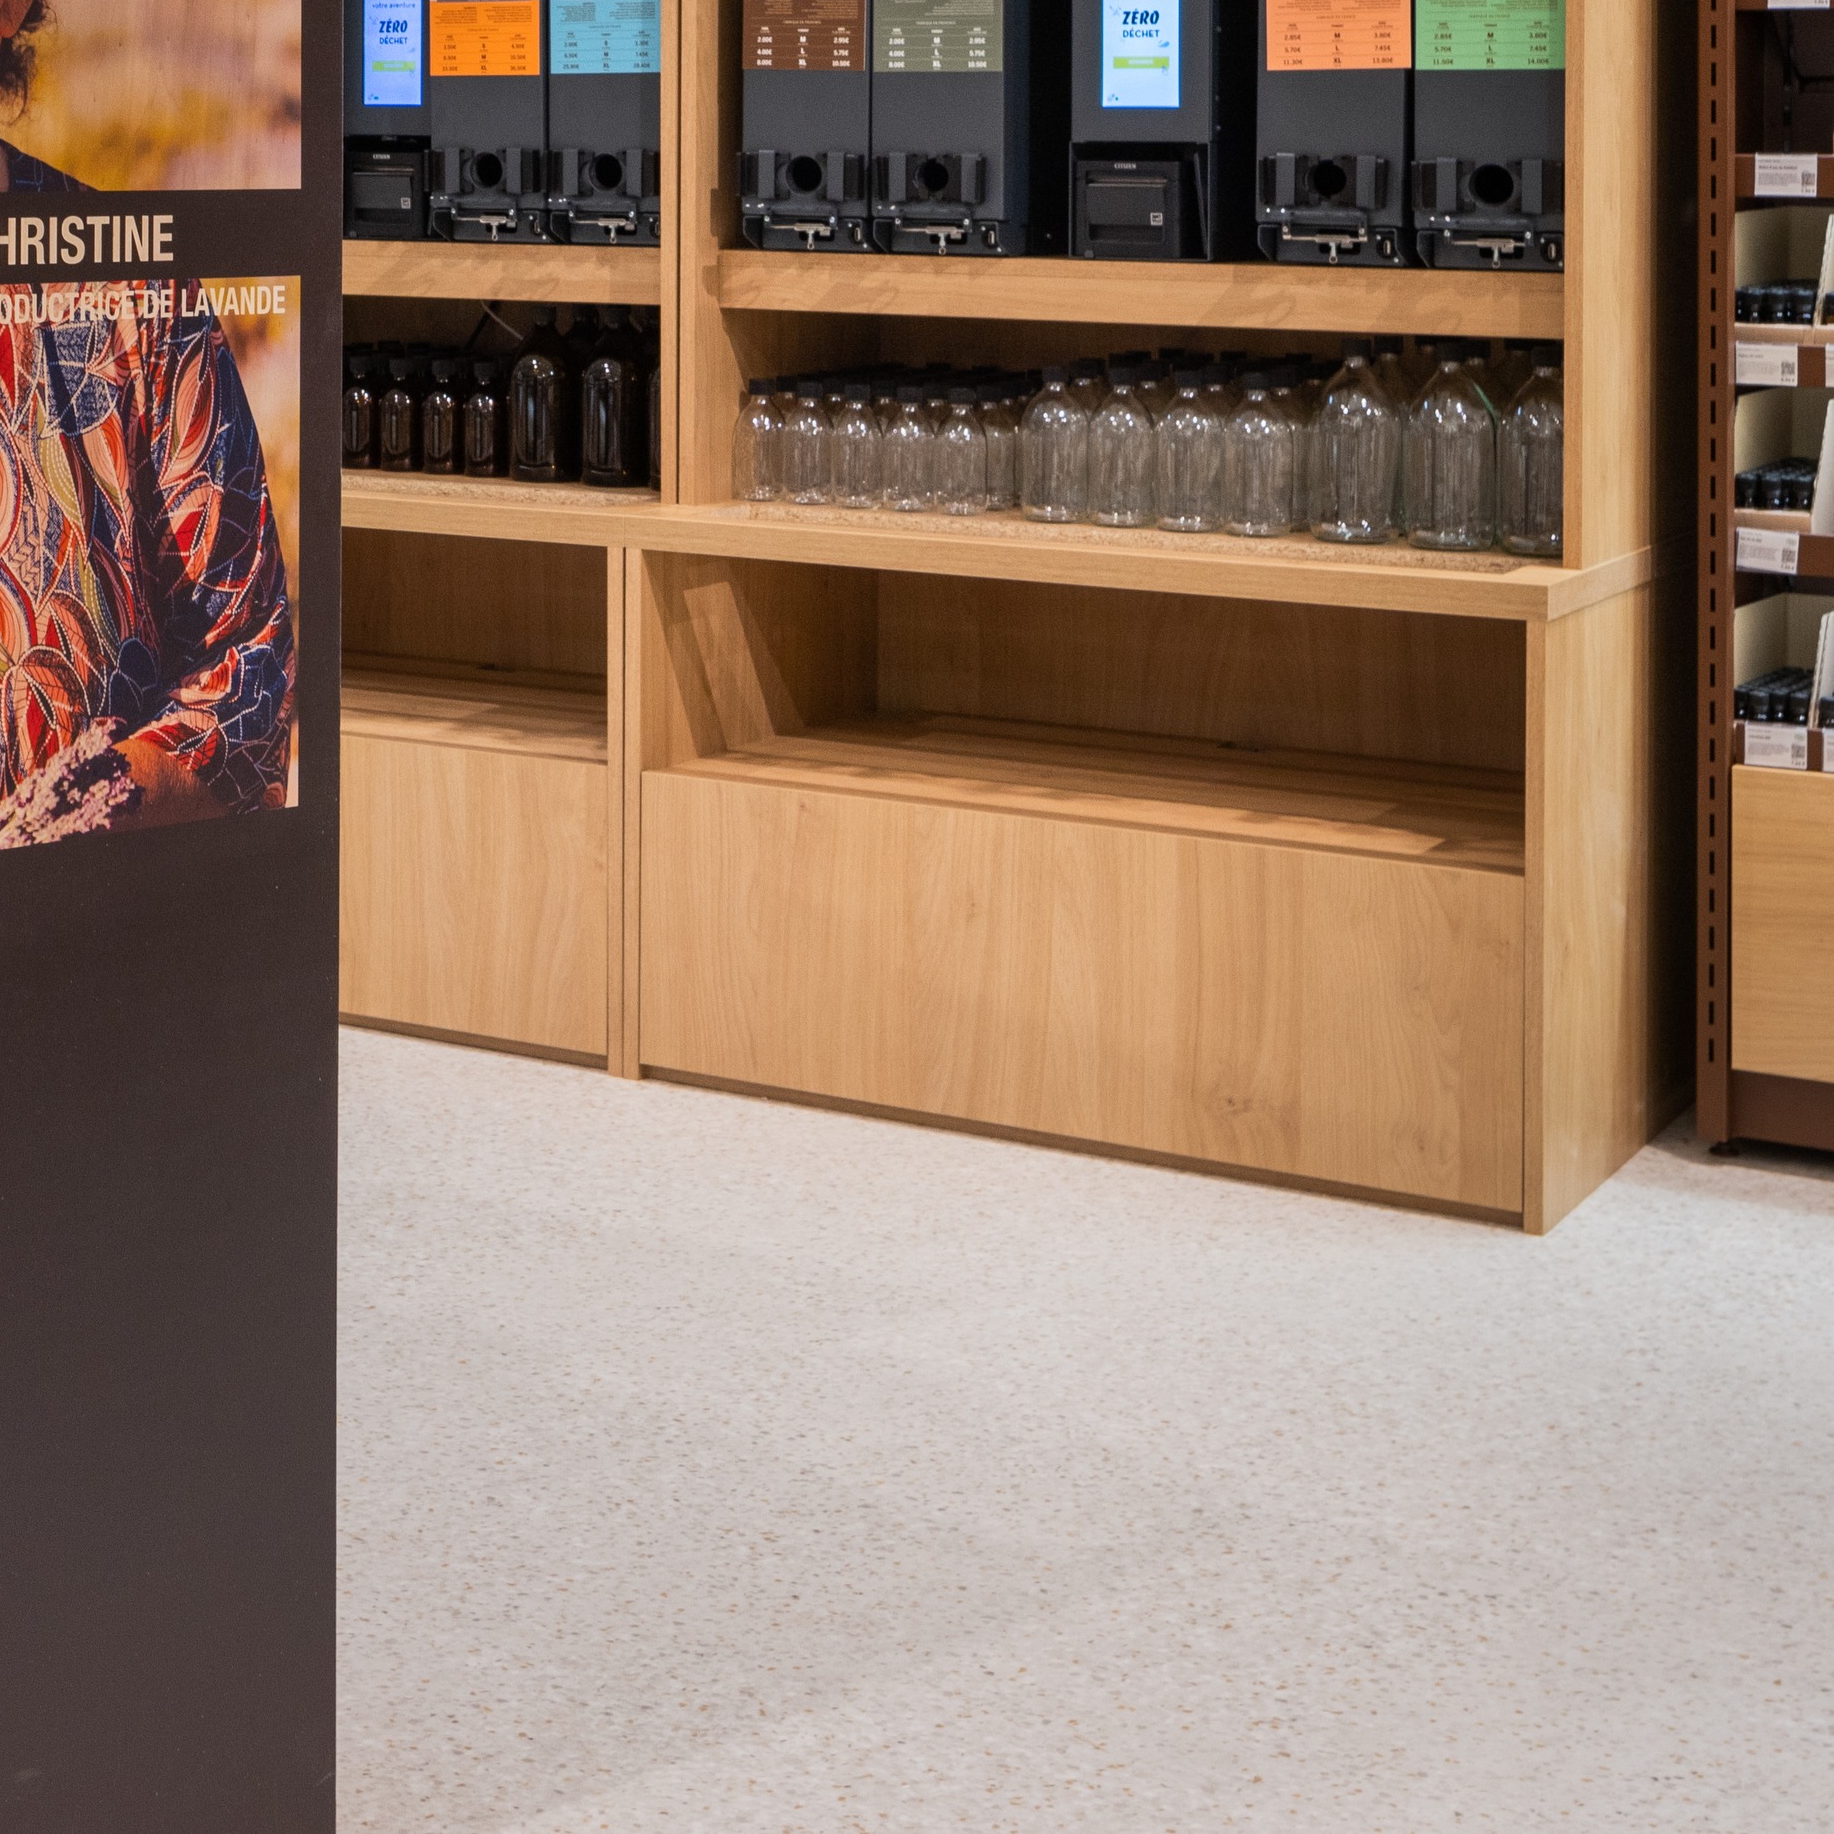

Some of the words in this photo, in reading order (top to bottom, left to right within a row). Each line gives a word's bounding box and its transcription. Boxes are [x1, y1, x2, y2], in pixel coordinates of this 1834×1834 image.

[1121, 7, 1160, 25] ZÉRO
[378, 18, 408, 33] ZÉRO
[1122, 27, 1160, 38] DÉCHET
[379, 36, 408, 45] DÉCHET
[142, 289, 172, 319] DE
[181, 285, 286, 318] LAVANDE
